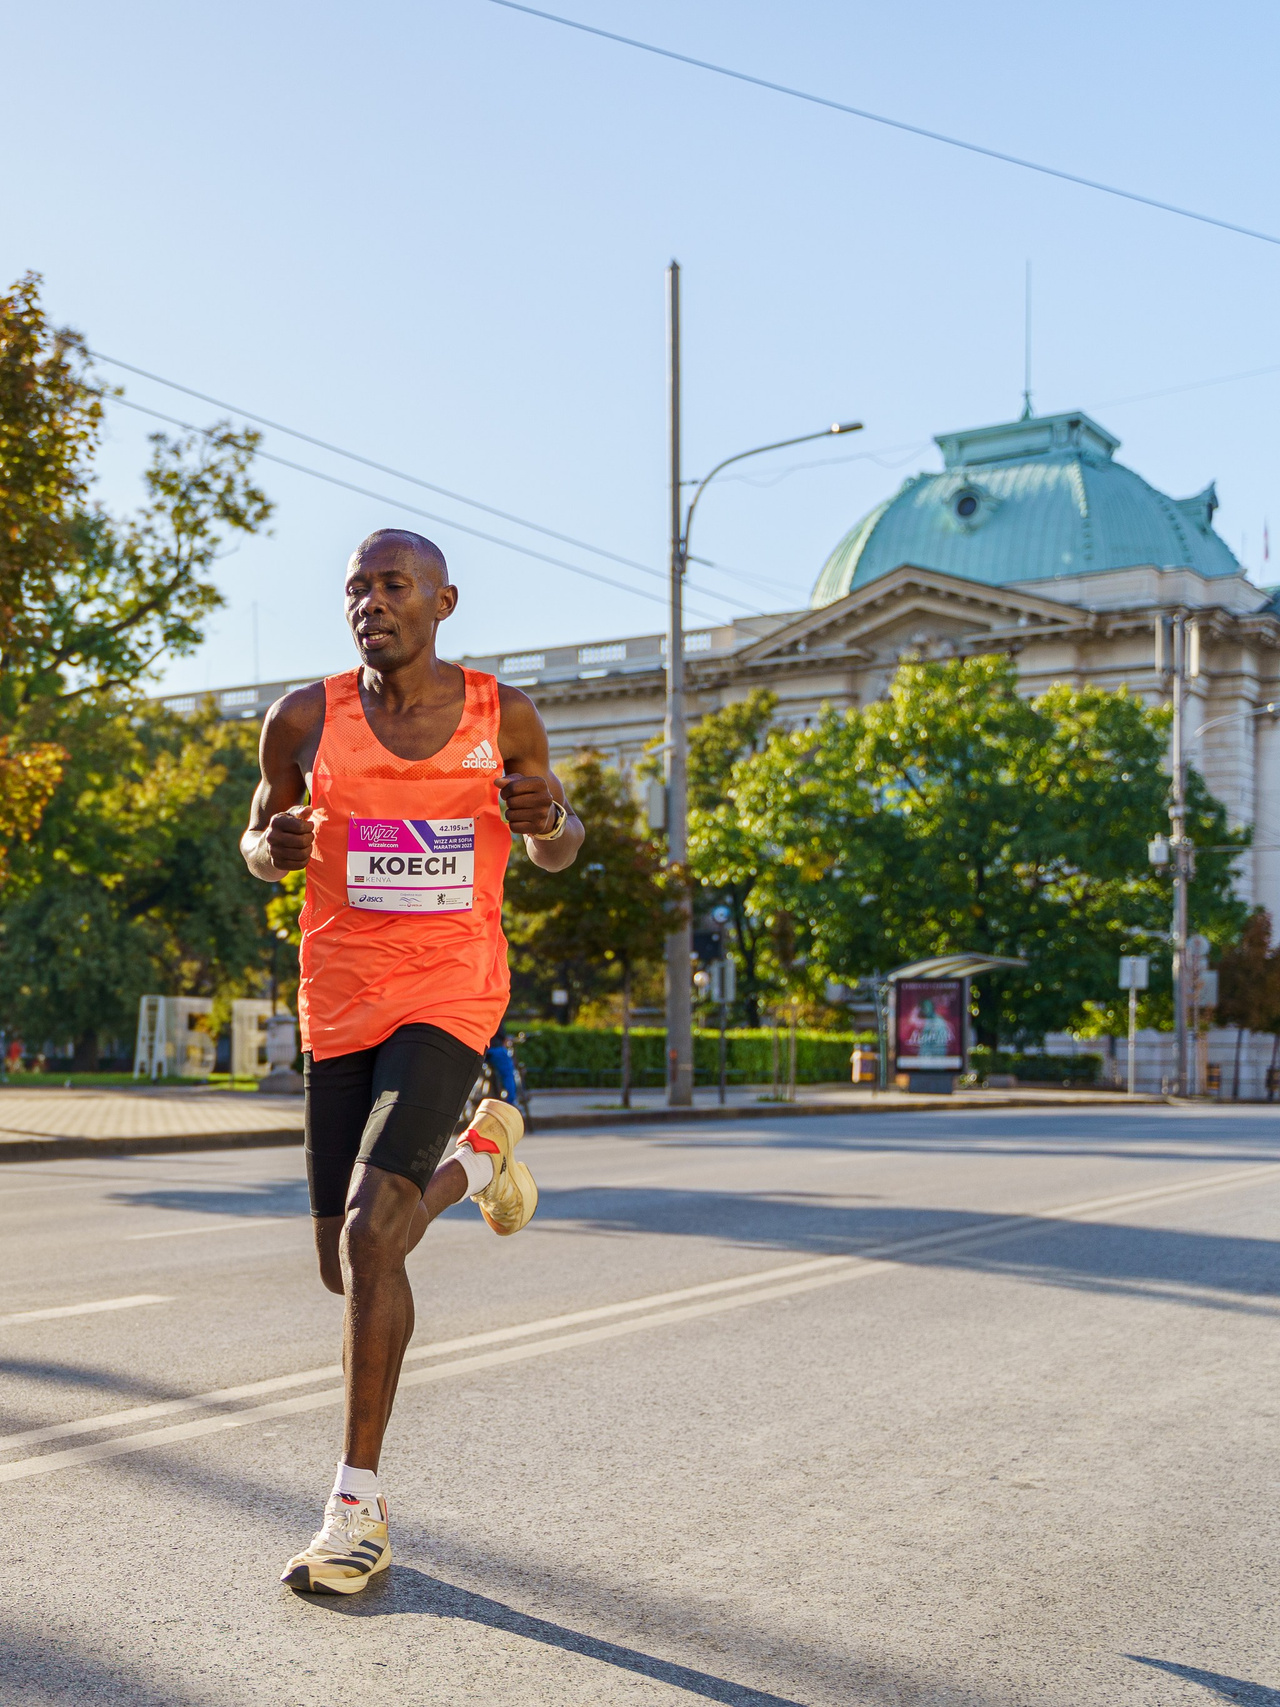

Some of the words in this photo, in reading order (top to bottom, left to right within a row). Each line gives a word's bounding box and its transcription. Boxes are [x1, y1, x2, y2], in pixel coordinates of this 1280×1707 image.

[462, 757, 497, 769] adidas
[439, 824, 461, 832] 42.195
[369, 856, 456, 875] KOECH
